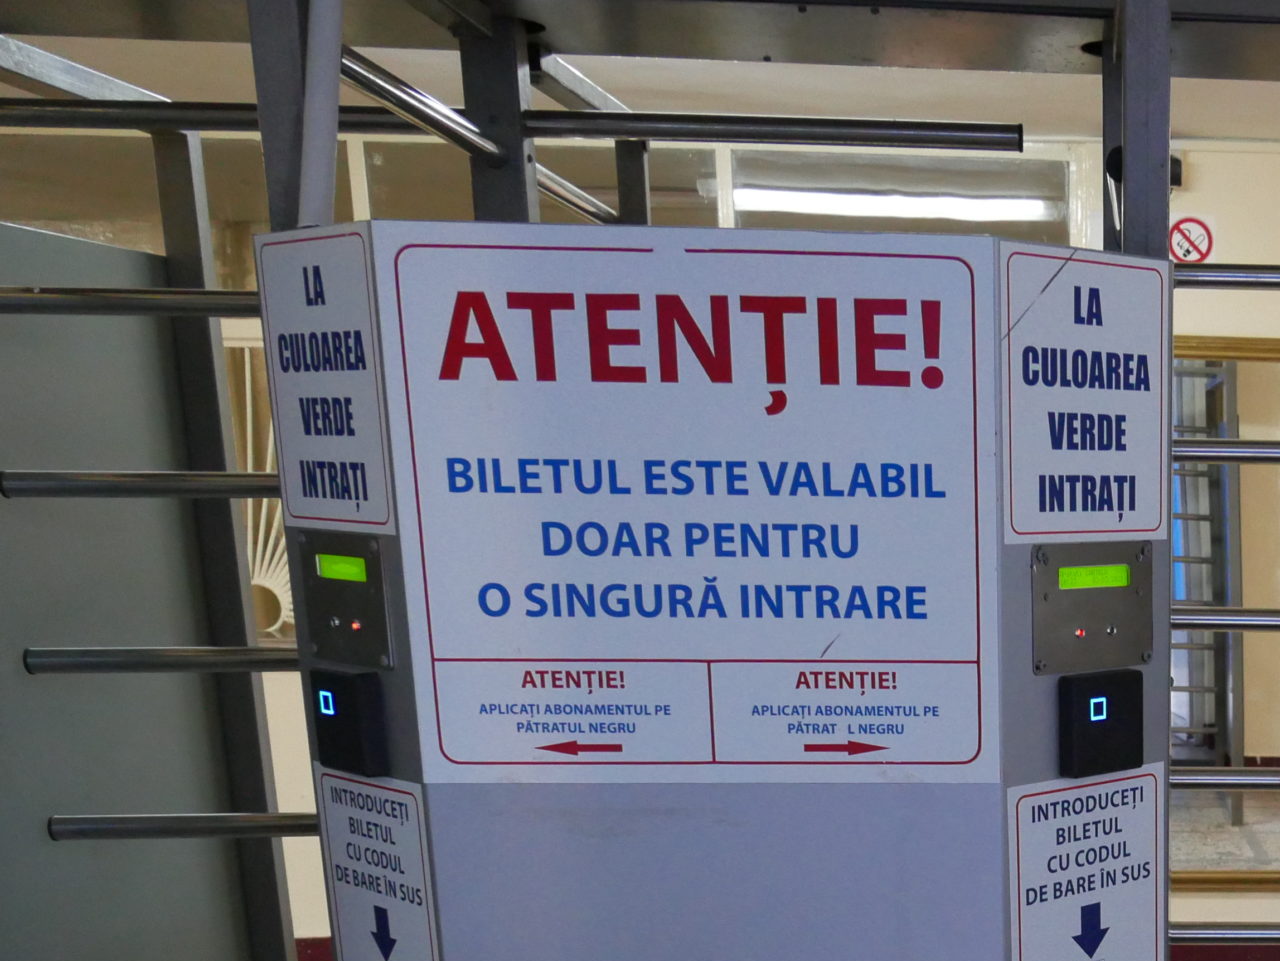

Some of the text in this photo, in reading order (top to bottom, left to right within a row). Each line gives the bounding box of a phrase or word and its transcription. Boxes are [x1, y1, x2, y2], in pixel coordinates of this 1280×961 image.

[302, 265, 326, 306] LA
[1073, 285, 1103, 327] LA
[277, 330, 367, 373] CULOAREA
[438, 290, 944, 416] ATENȚIE!
[1022, 345, 1151, 392] CULOAREA
[298, 397, 356, 437] VERDE
[1047, 411, 1127, 452] VERDE
[299, 460, 368, 512] INTRAȚI
[445, 457, 946, 499] BILETUL ESTE VALABIL
[1038, 474, 1136, 523] INTRAȚI
[540, 520, 859, 560] DOAR PENTRU
[477, 576, 928, 620] O SINGURĂ INTRARE
[521, 670, 625, 694] ATENȚIE!
[795, 671, 898, 696] ATENȚIE!
[479, 703, 671, 718] APLICAȚI ABONAMENTUL PE
[516, 720, 636, 734] PĂTRATUL NEGRU
[751, 704, 940, 719] APLICAȚI ABONAMENTUL PE
[858, 723, 905, 735] NEGRU
[330, 786, 409, 825] INTRODUCEȚI
[1031, 786, 1144, 823] INTRODUCEȚI
[348, 816, 396, 845] BILETUL
[1056, 816, 1122, 845] BILETUL
[346, 842, 405, 875] CU CODUL
[1047, 840, 1131, 874] CU CODUL
[335, 864, 422, 906] DE BARE ÎN SUS
[1026, 861, 1151, 906] DE BARE ÎN SUS
